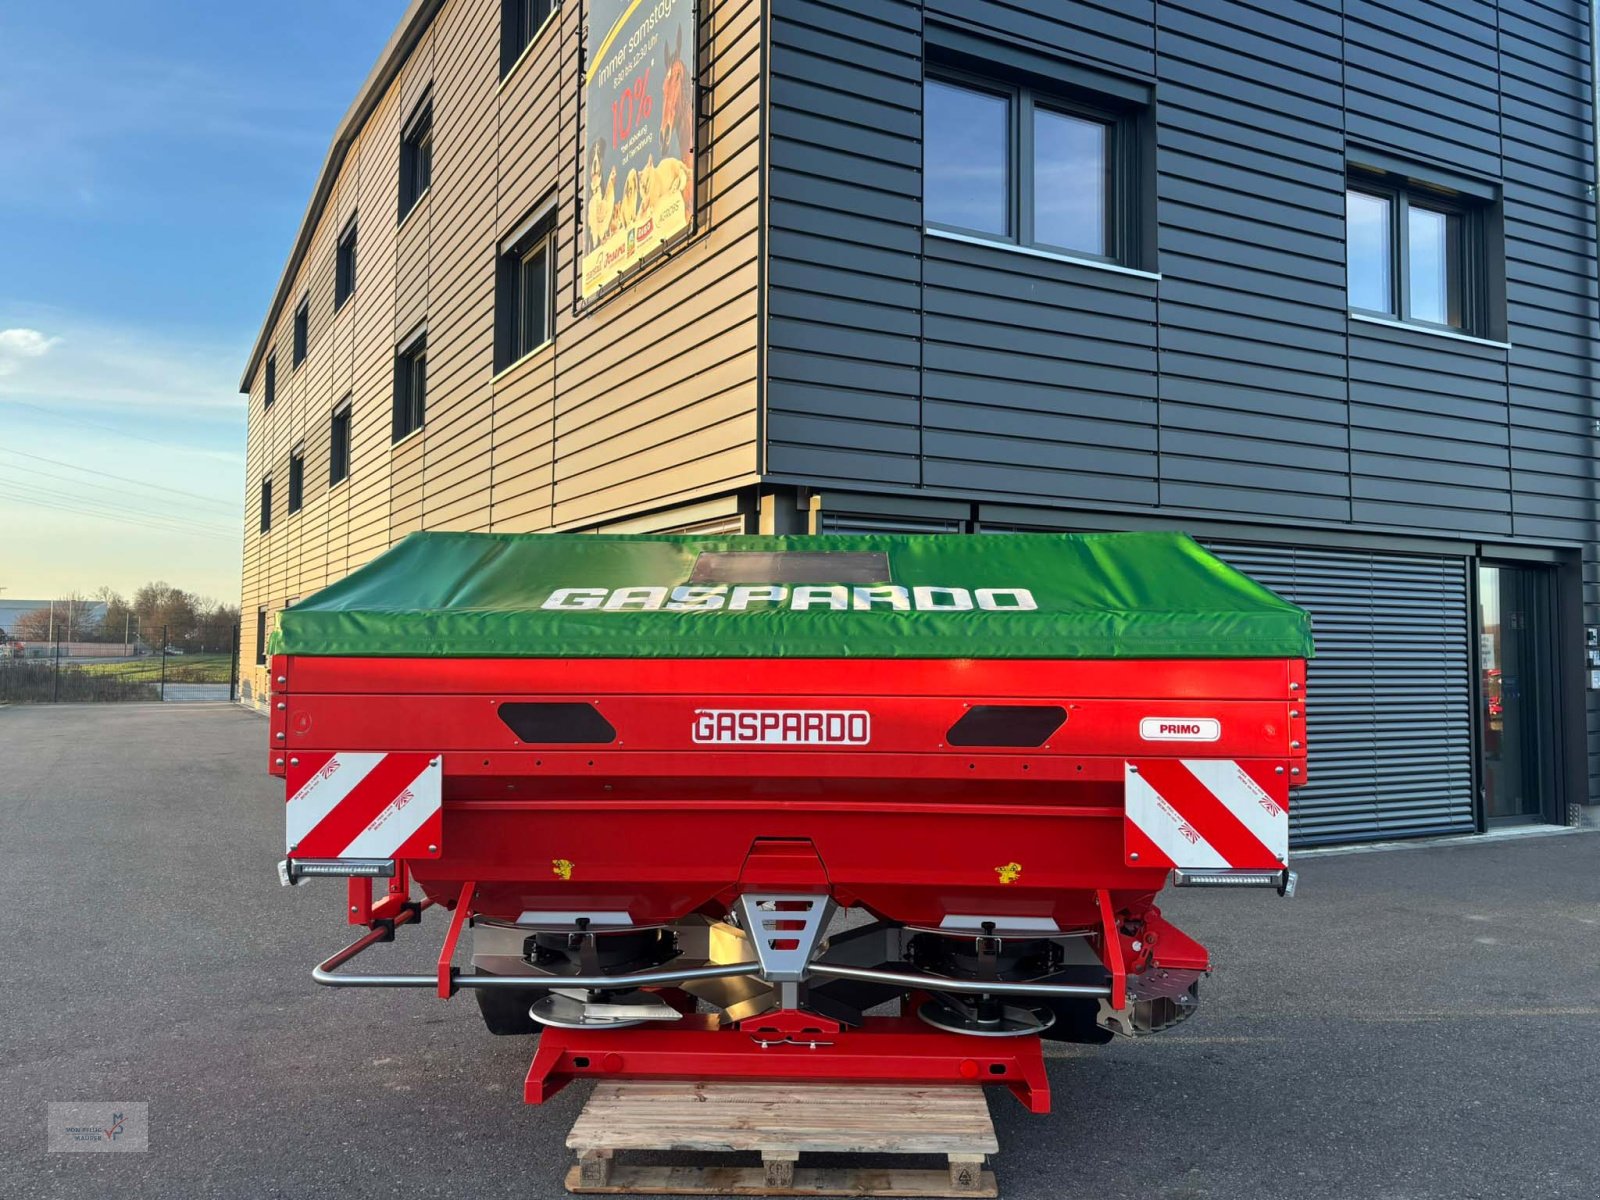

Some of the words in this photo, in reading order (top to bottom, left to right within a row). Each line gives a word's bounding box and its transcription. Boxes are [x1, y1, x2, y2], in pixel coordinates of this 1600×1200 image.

[598, 44, 628, 88] immer
[629, 0, 676, 52] samstag
[540, 585, 1038, 611] GASPARDO
[694, 711, 868, 742] GASPARDO
[1159, 724, 1201, 735] PRIMO
